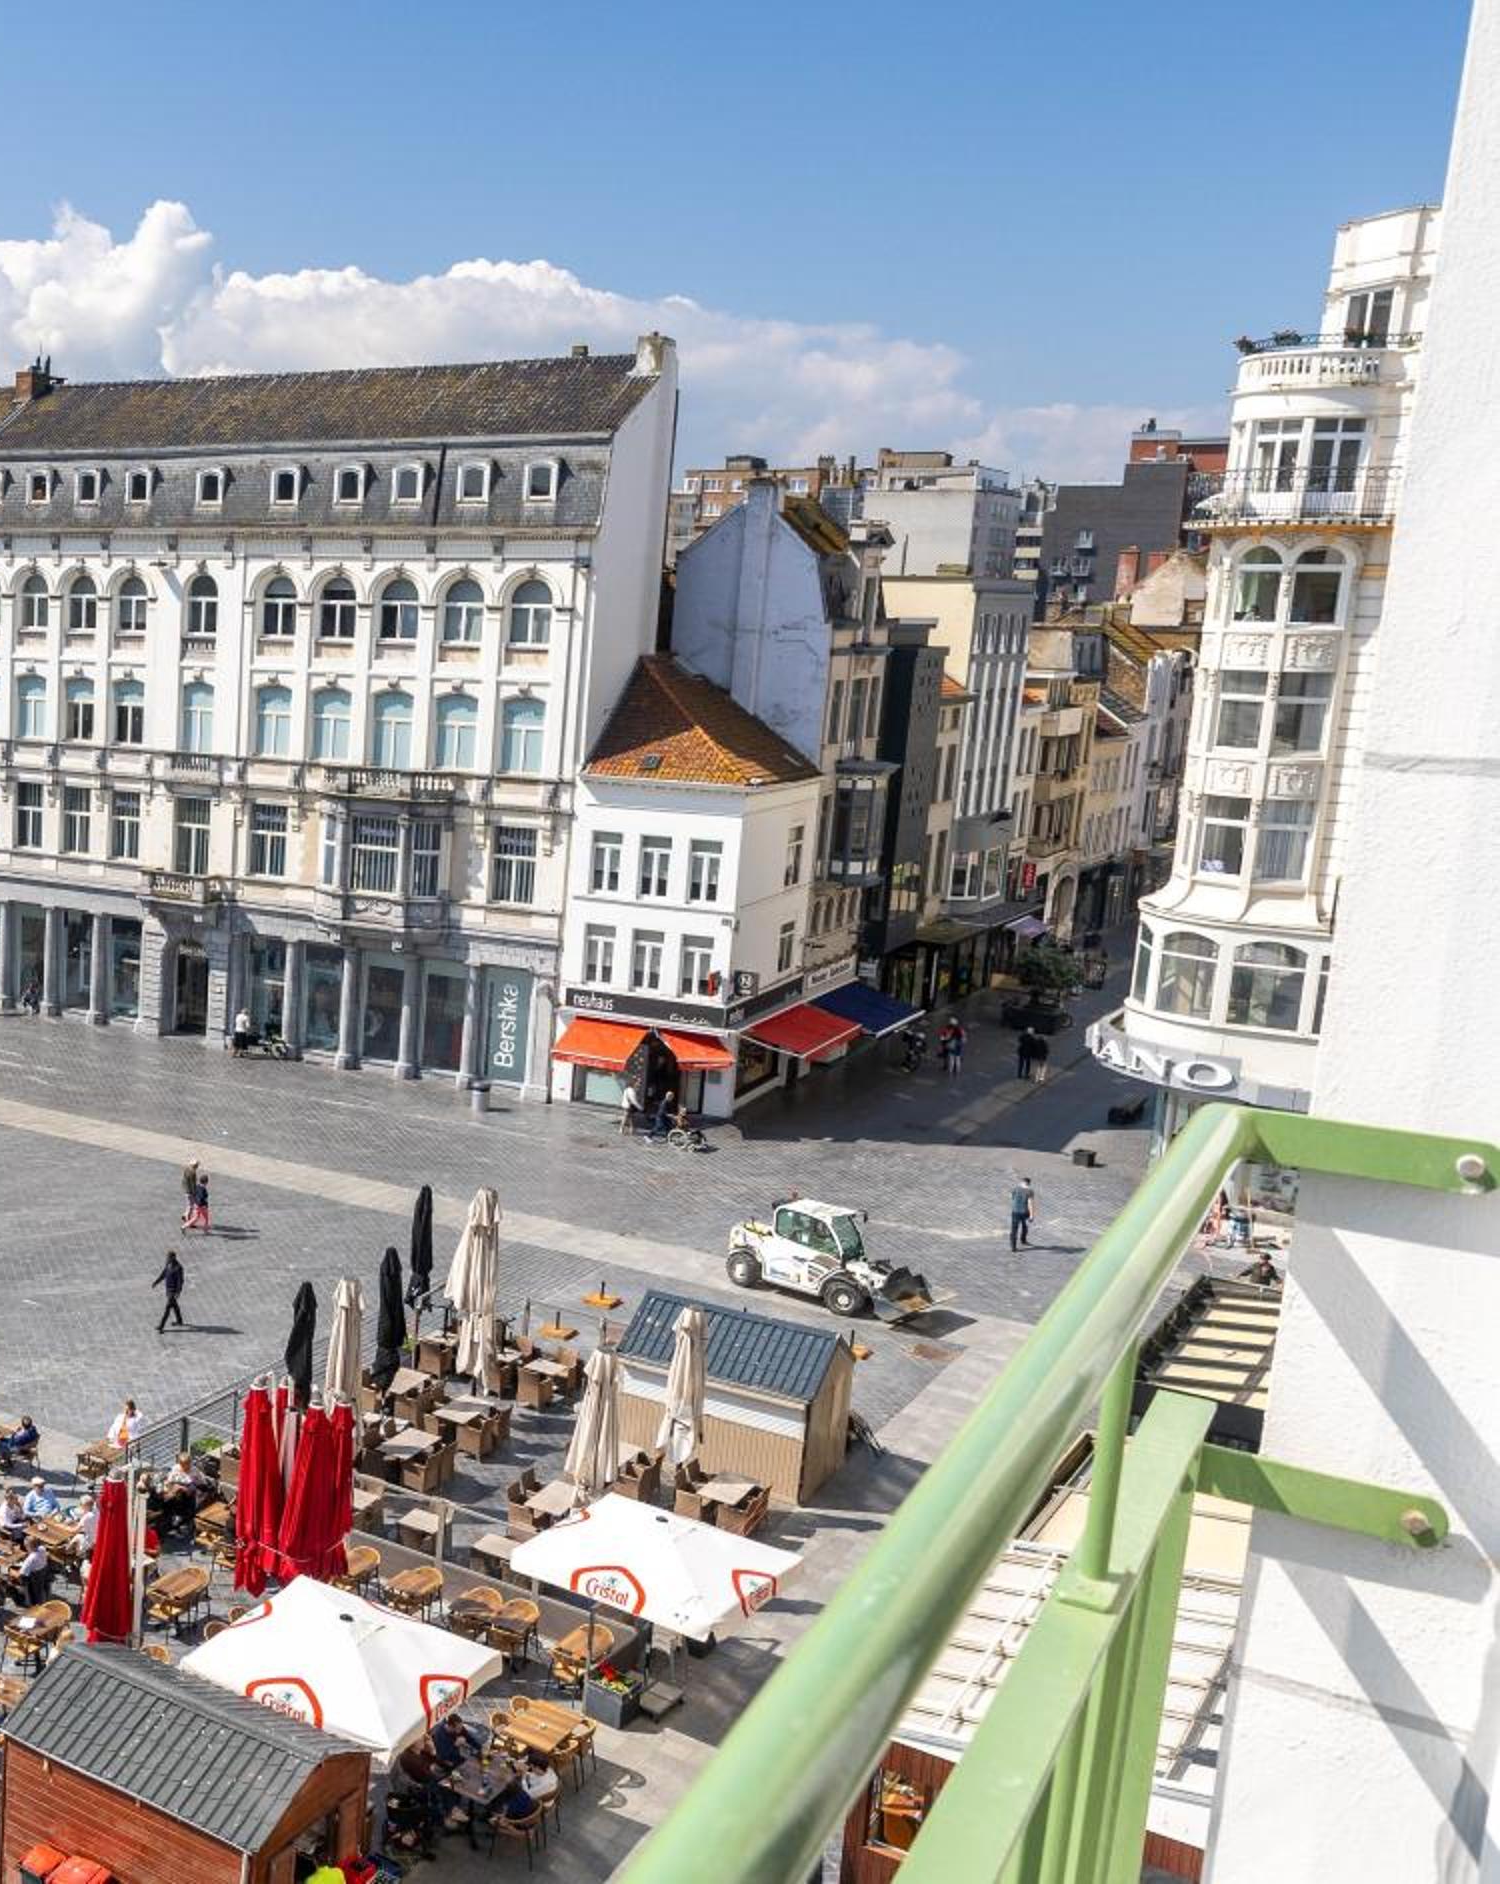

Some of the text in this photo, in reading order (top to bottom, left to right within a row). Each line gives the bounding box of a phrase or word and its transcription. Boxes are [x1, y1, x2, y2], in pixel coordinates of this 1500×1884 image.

[573, 991, 613, 1011] neuhaus
[493, 983, 519, 1069] Bershka
[585, 1577, 629, 1606] Cristal
